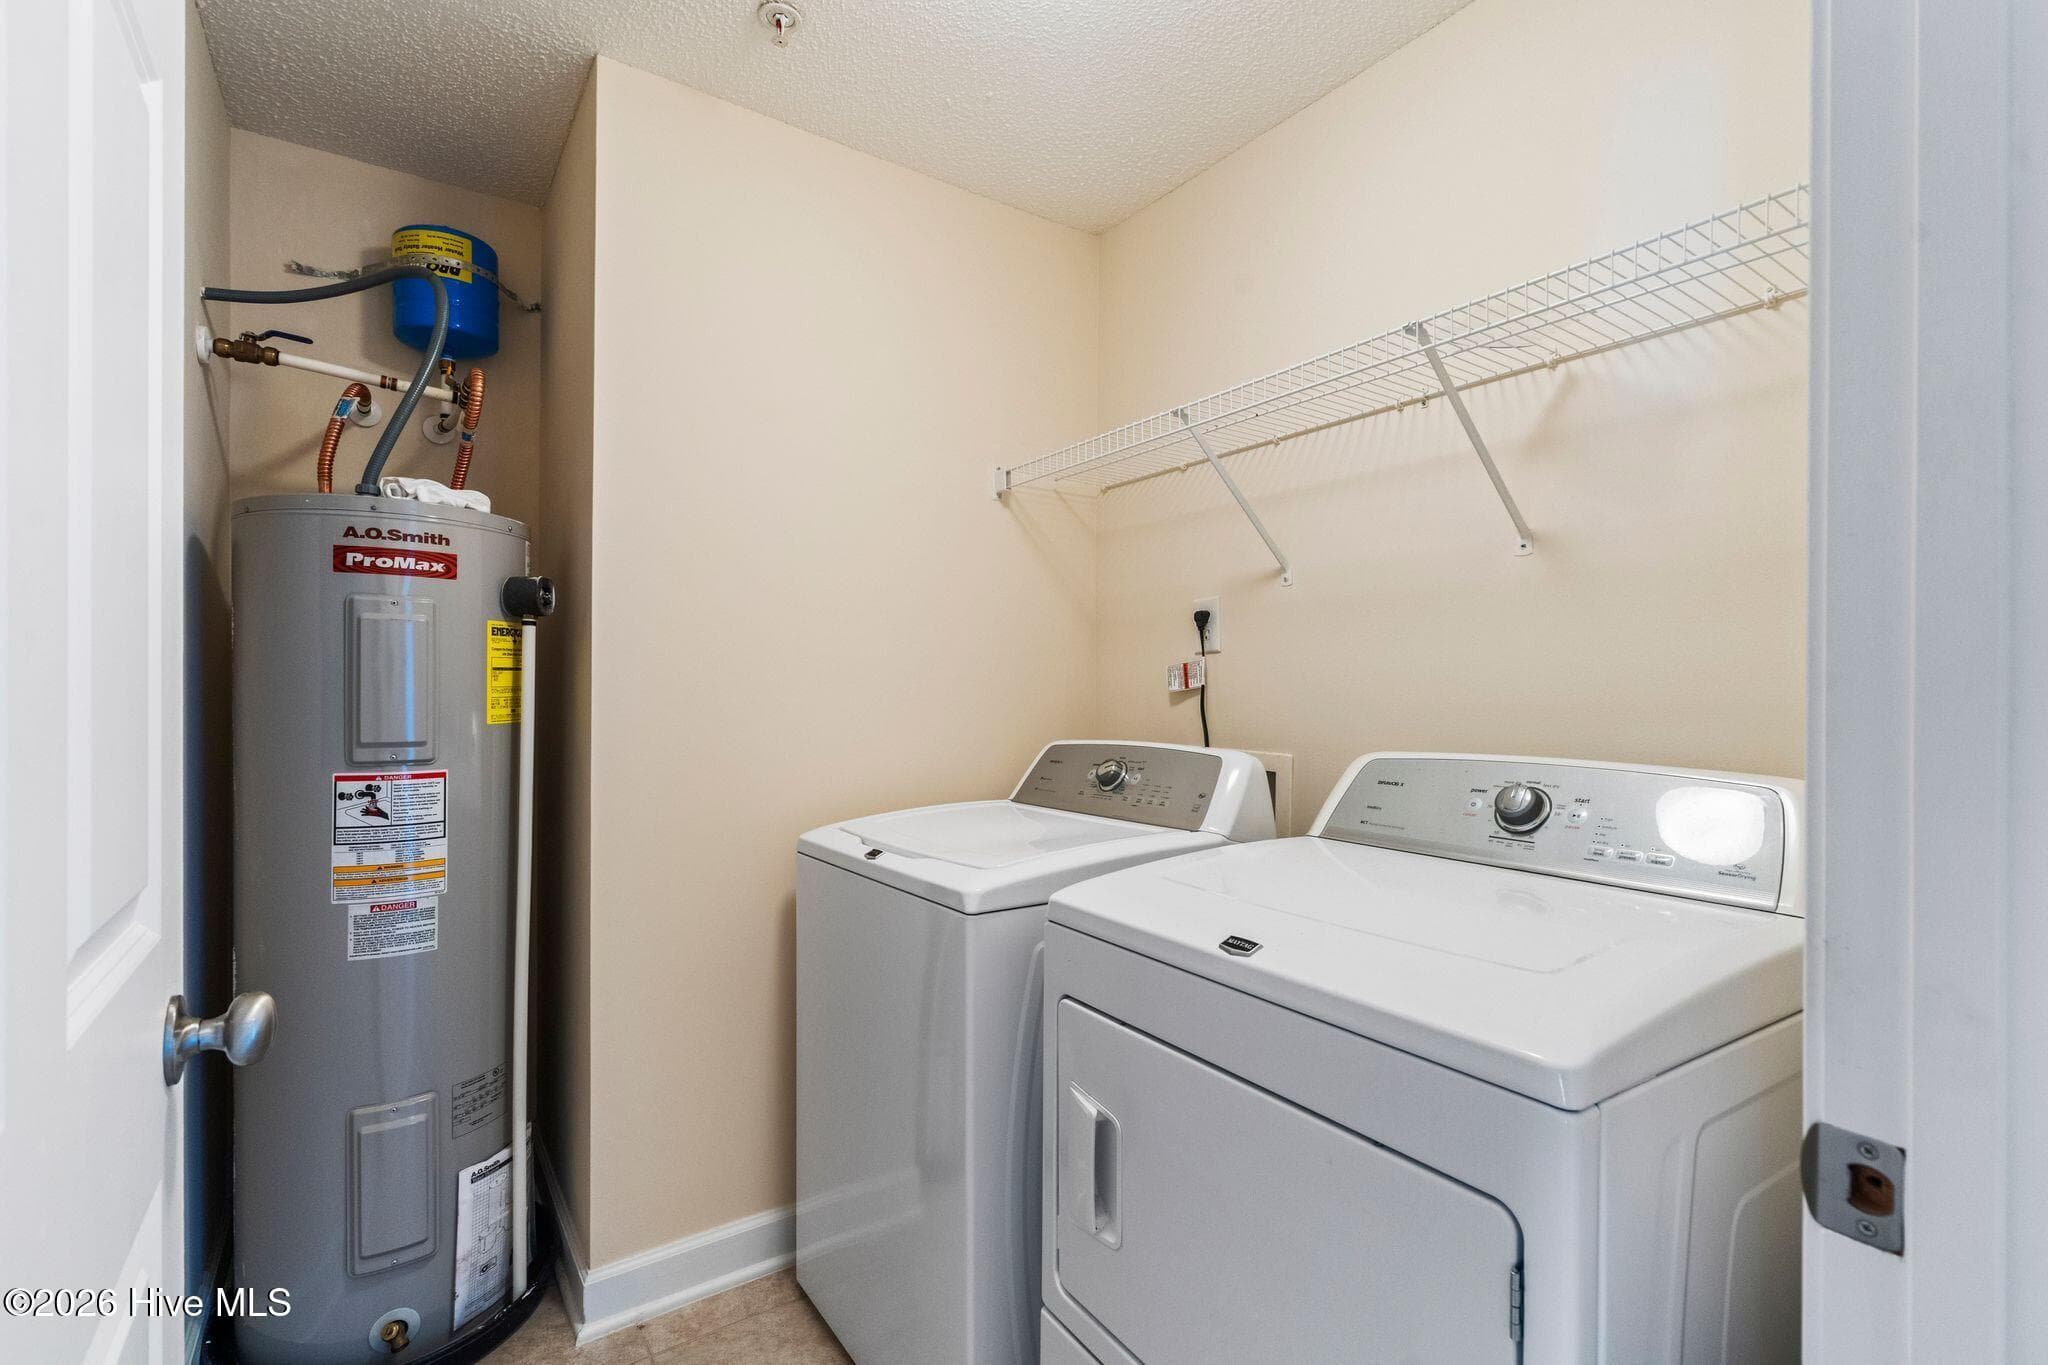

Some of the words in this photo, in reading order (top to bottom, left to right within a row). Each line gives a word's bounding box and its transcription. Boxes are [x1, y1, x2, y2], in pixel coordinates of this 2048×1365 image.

[342, 526, 451, 547] A.O.Smith
[345, 552, 446, 573] ProMax
[381, 901, 416, 911] DANGER
[1227, 938, 1255, 950] MAYTAG
